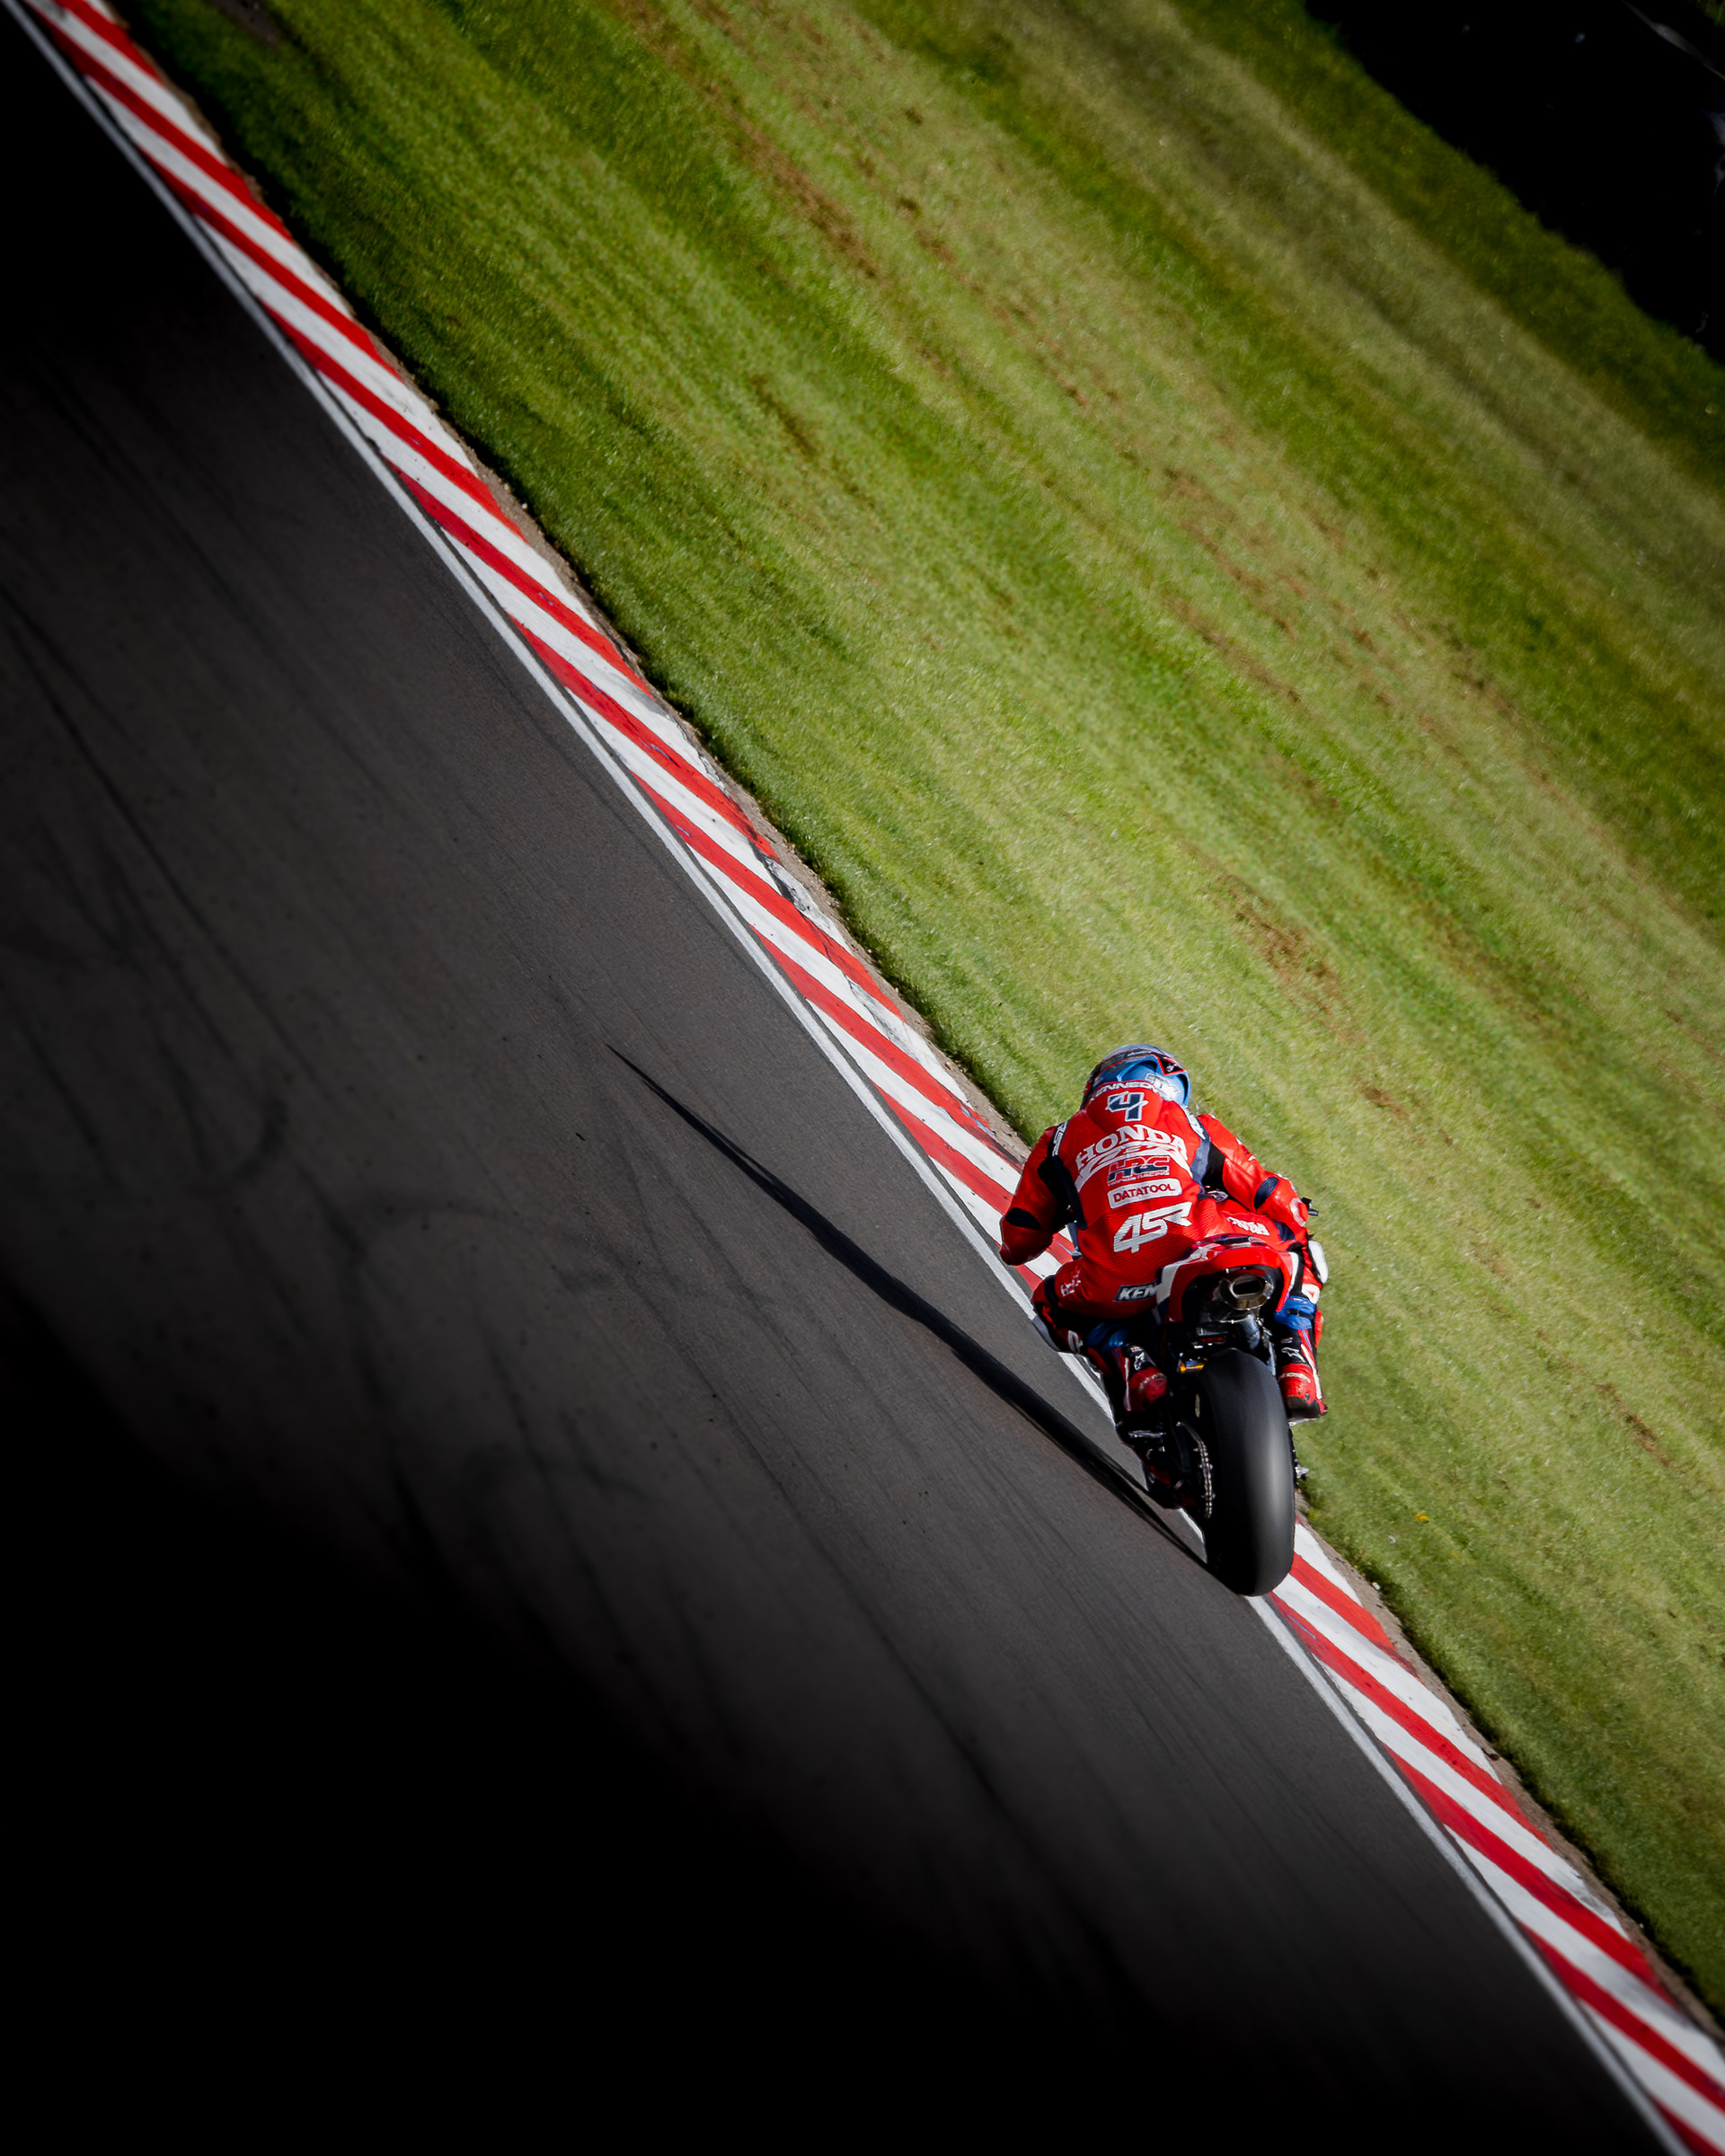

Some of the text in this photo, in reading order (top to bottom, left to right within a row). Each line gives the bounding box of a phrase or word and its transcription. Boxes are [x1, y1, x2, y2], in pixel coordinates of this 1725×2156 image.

[1105, 1091, 1149, 1122] 4
[1075, 1124, 1188, 1171] HONDA
[1108, 1155, 1170, 1183] HRC
[1113, 1183, 1176, 1203] DATATOOL
